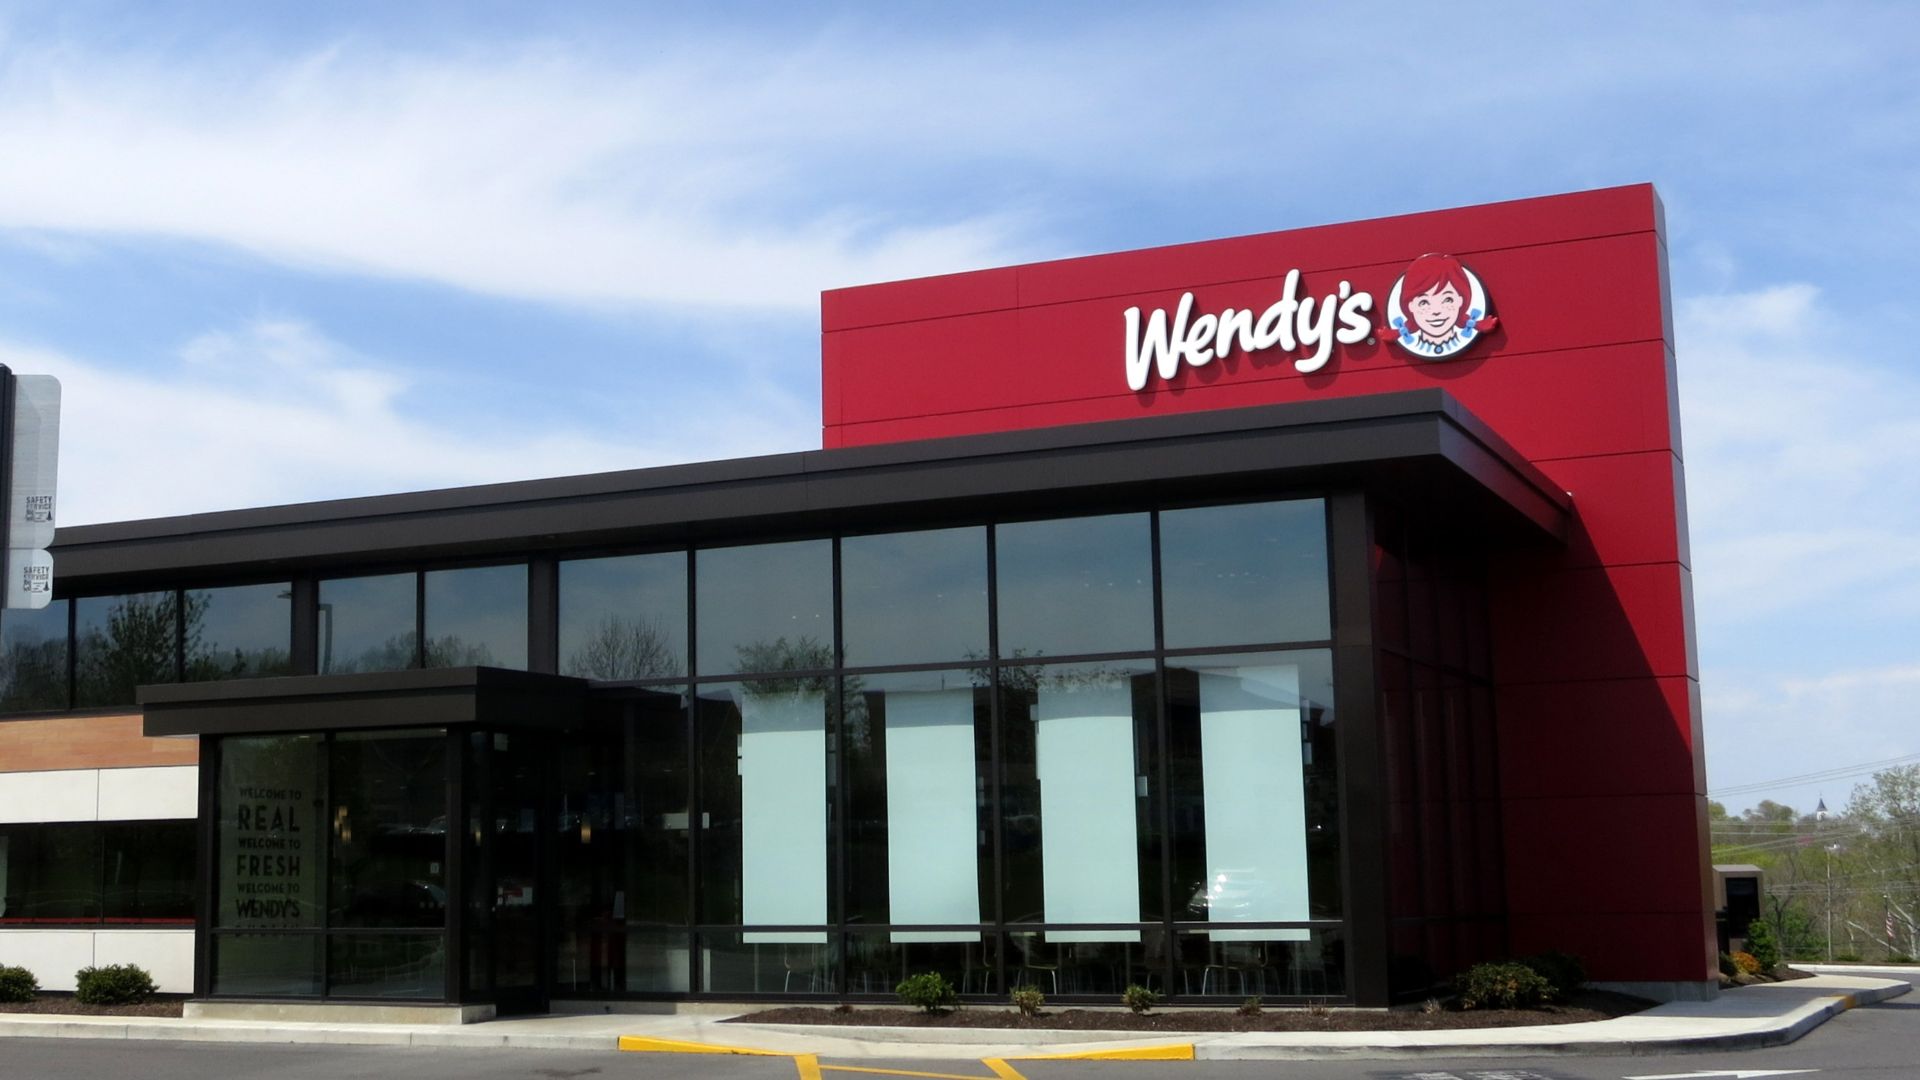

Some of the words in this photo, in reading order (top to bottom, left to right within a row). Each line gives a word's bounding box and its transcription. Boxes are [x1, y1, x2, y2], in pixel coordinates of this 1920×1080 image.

[1124, 268, 1373, 391] Wendy's
[239, 788, 286, 800] WELCOME
[289, 789, 302, 800] TO
[238, 804, 300, 832] REAL
[238, 838, 285, 849] WELCOME
[289, 839, 301, 849] TO
[236, 855, 300, 876] FRESH
[237, 883, 284, 893] WELCOME
[287, 883, 300, 893] TO
[235, 898, 300, 918] WENDY'S
